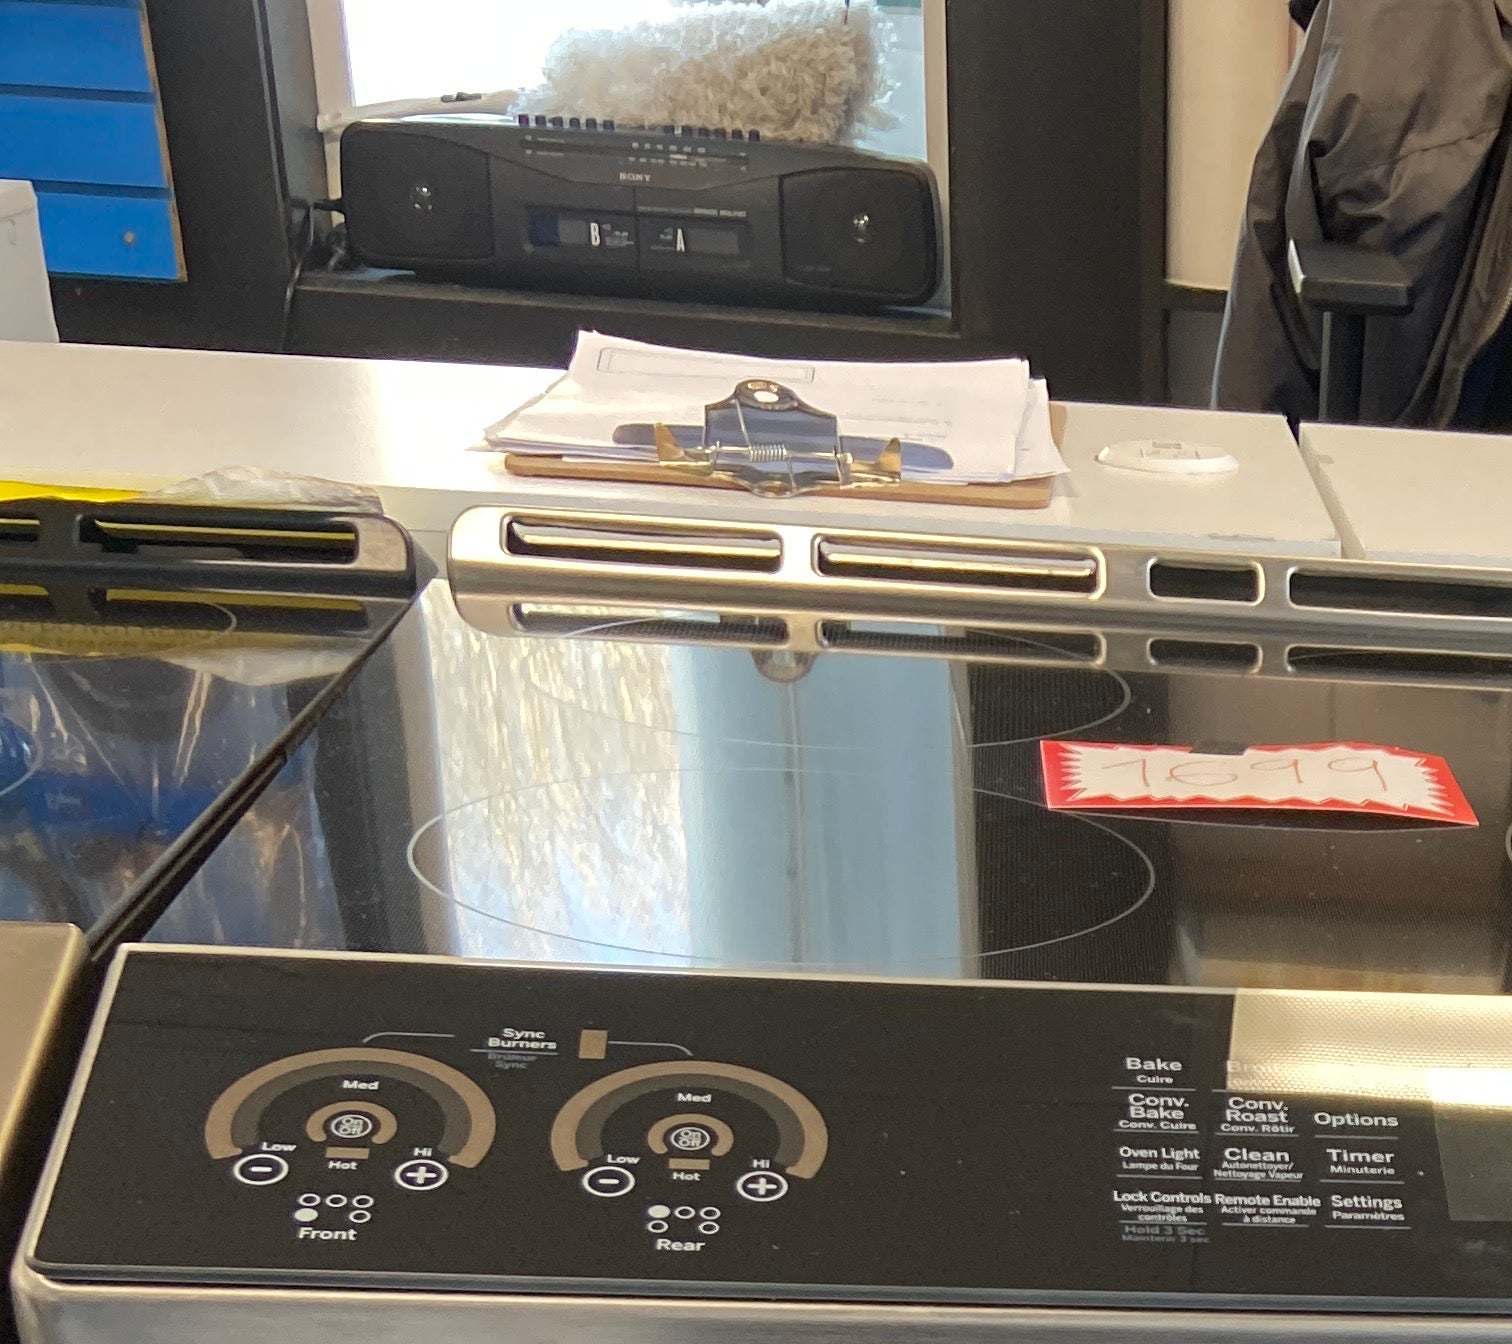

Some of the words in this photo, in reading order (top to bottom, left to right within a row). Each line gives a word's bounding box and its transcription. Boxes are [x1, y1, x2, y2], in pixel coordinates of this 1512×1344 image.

[590, 222, 601, 246] B
[676, 228, 686, 252] A
[1100, 757, 1388, 792] 1699
[503, 1028, 546, 1039] Sync
[488, 1037, 558, 1050] Burners
[1126, 1057, 1183, 1071] Bake
[342, 1080, 380, 1091] Med
[1136, 1075, 1174, 1084] Cuire
[677, 1093, 712, 1103] Med
[1128, 1093, 1190, 1107] Conv.
[1228, 1096, 1289, 1110] Conv.
[1129, 1105, 1185, 1119] Bake
[1225, 1109, 1289, 1123] Roast
[1160, 1121, 1197, 1130] Cuire
[1314, 1112, 1399, 1127] Options
[261, 1141, 297, 1152] Low
[413, 1147, 433, 1158] Hi
[1119, 1146, 1158, 1158] Oven
[1161, 1147, 1201, 1161] Light
[606, 1154, 641, 1165] Low
[1224, 1147, 1290, 1162] Clean
[1326, 1148, 1395, 1163] Timer
[327, 1160, 358, 1171] Hot
[752, 1158, 770, 1169] Hi
[1330, 1165, 1396, 1175] Minuterie
[672, 1171, 702, 1182] Hot
[1113, 1190, 1148, 1201] Lock
[1150, 1191, 1212, 1204] Controls
[1215, 1193, 1271, 1206] Remote
[1272, 1194, 1322, 1207] Enable
[1331, 1195, 1403, 1211] Settings
[298, 1227, 358, 1241] Front
[656, 1238, 706, 1252] Rear
